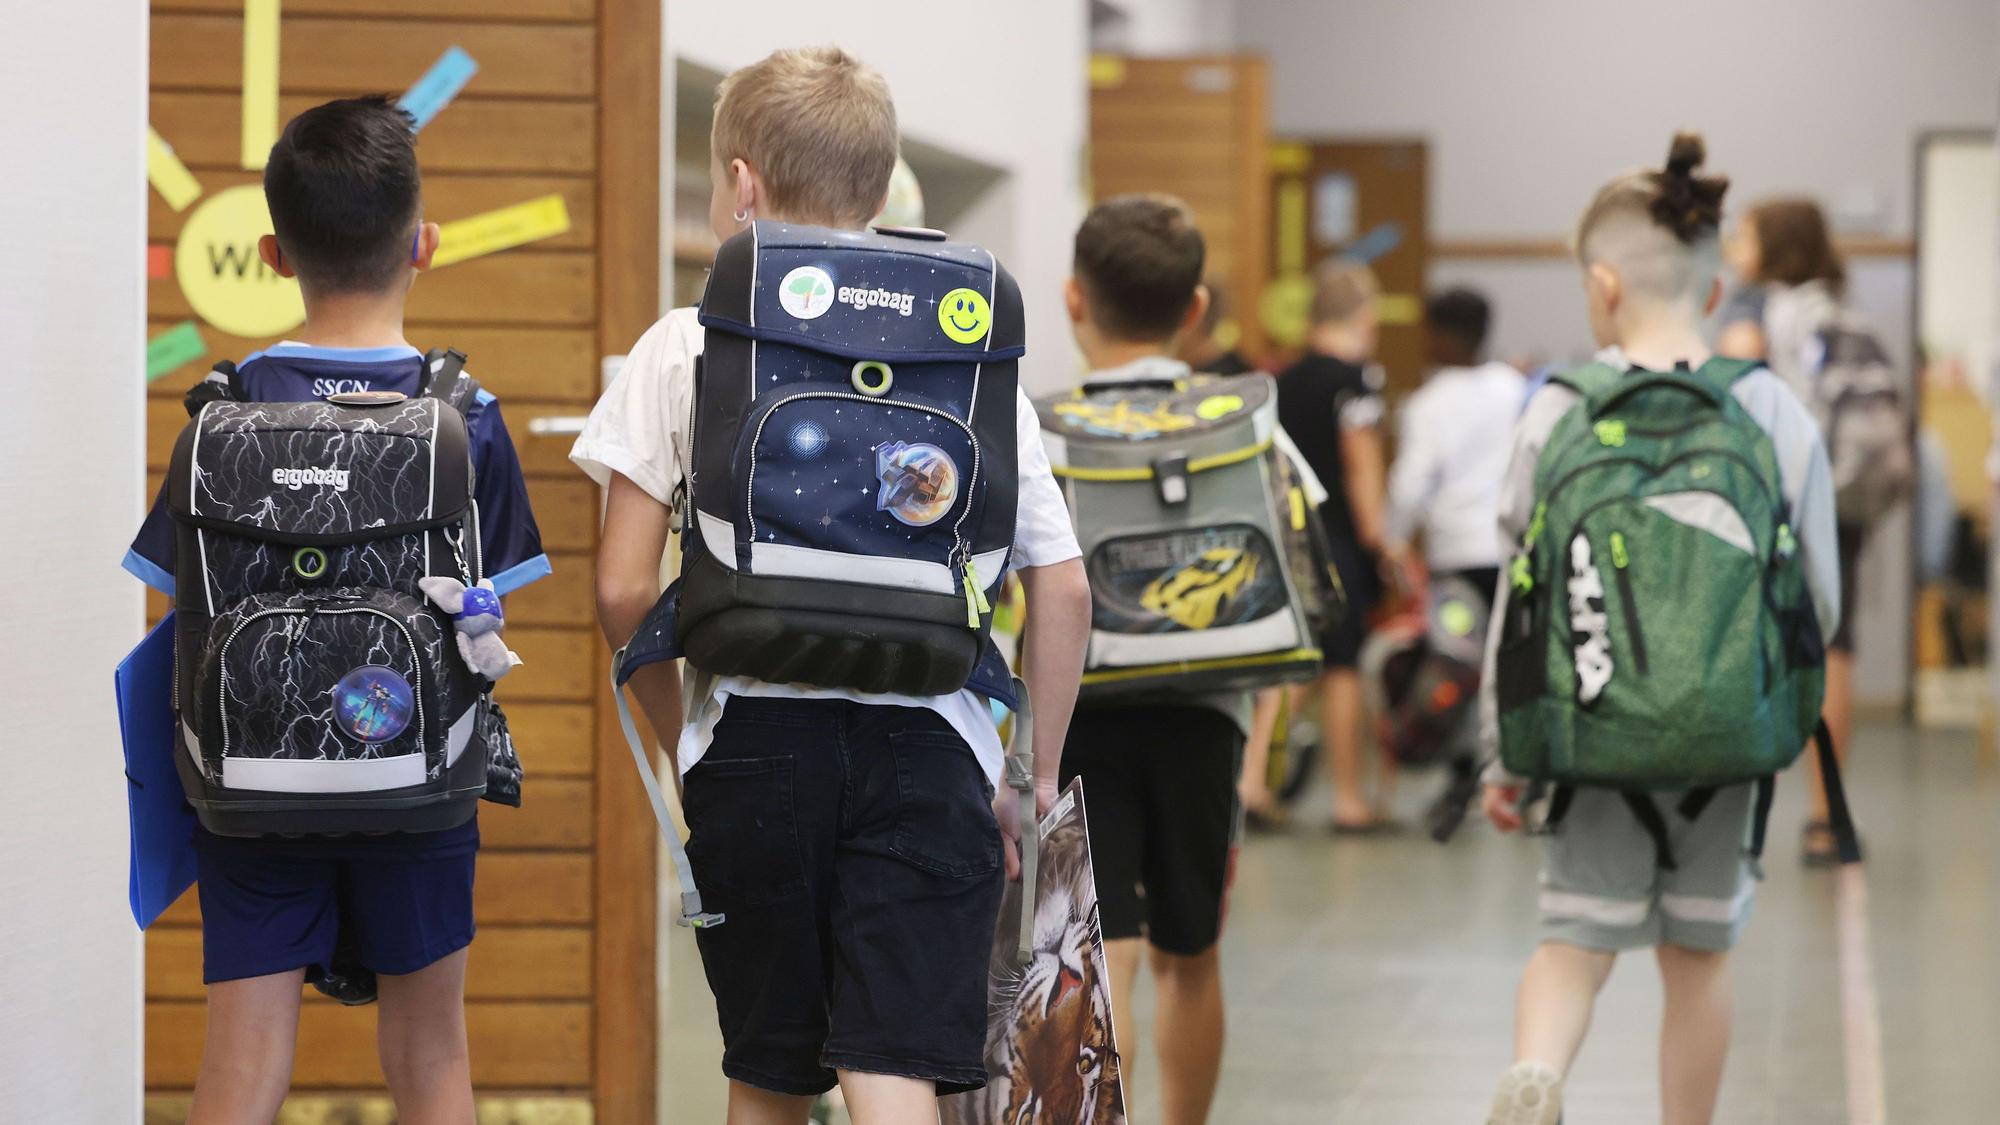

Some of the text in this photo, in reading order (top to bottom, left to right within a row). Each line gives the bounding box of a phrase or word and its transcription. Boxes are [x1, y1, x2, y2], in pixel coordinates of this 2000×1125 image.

[838, 286, 915, 316] ergobag
[312, 378, 371, 396] SSCN
[272, 466, 350, 491] ergobag
